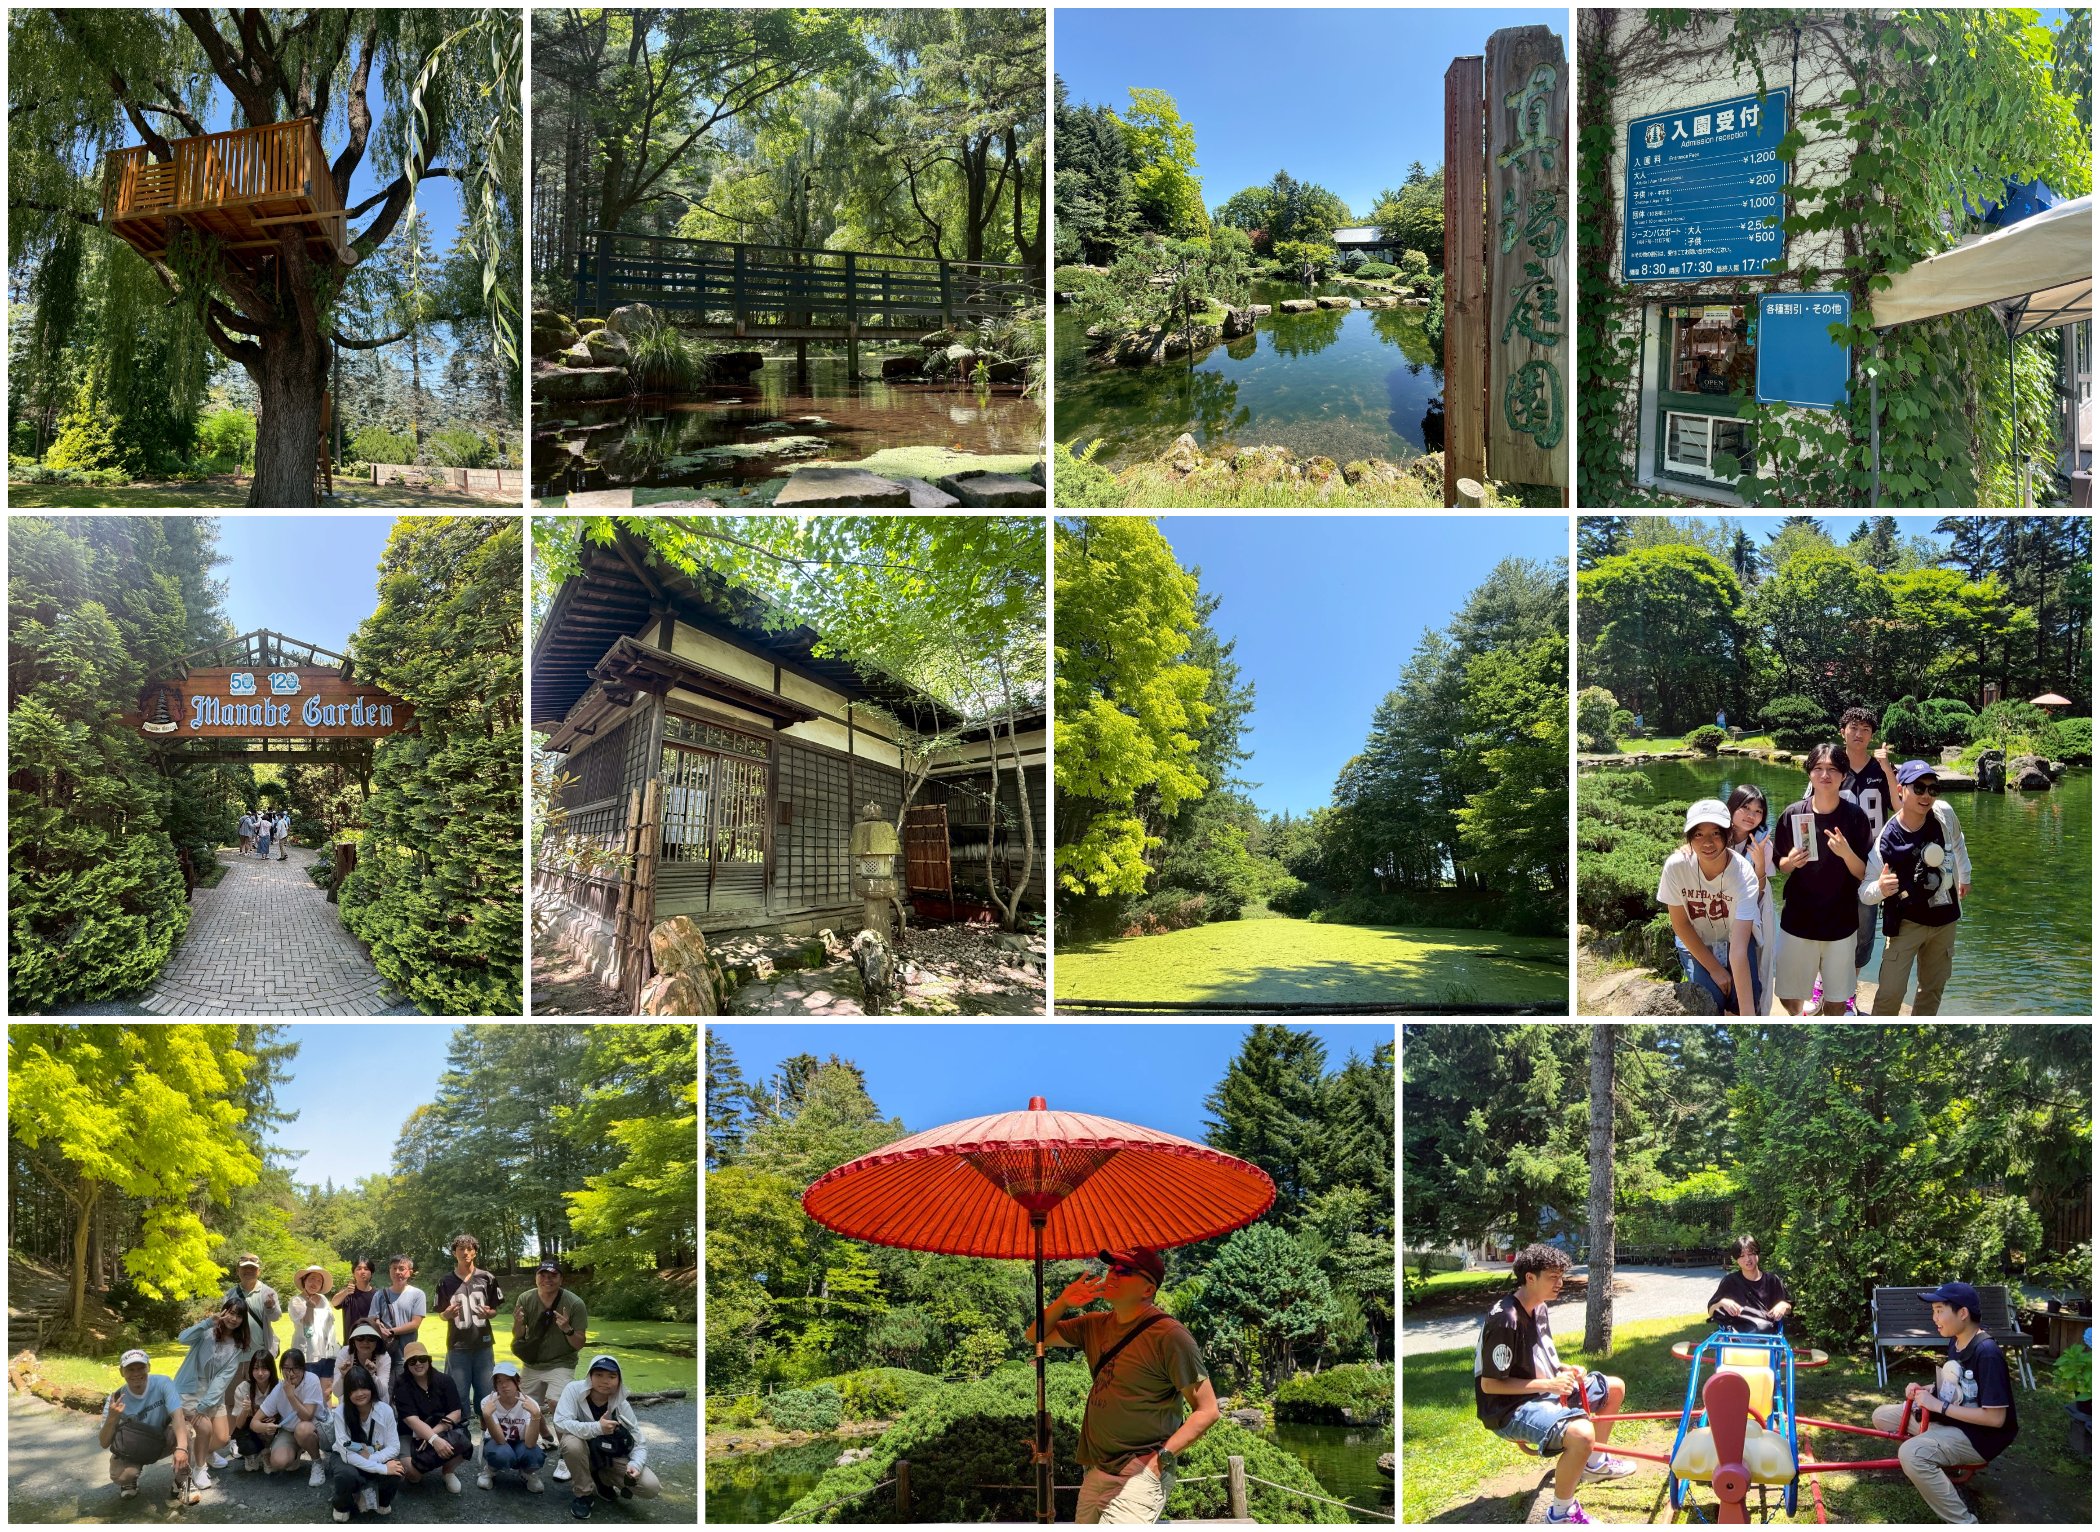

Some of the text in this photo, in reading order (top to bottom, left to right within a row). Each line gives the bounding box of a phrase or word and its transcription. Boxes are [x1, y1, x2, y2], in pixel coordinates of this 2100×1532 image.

[1671, 103, 1760, 141] 入園受付
[1681, 131, 1748, 148] Admission reception
[1743, 151, 1776, 164] ¥1,200
[1633, 171, 1646, 180] 大人
[1749, 173, 1776, 185] ¥200
[1633, 190, 1646, 200] 子供
[1742, 196, 1776, 208] ¥1,000
[1632, 210, 1646, 220] 団体
[1631, 227, 1681, 239] シーズンパスポート
[1748, 231, 1775, 242] ¥500
[1641, 263, 1666, 276] 8:30
[1681, 260, 1713, 274] 17:30
[1742, 257, 1778, 272] 17:0
[1766, 303, 1842, 315] 各種割引・その他
[1703, 379, 1724, 387] OPEN
[190, 694, 394, 729] Manabe Garden
